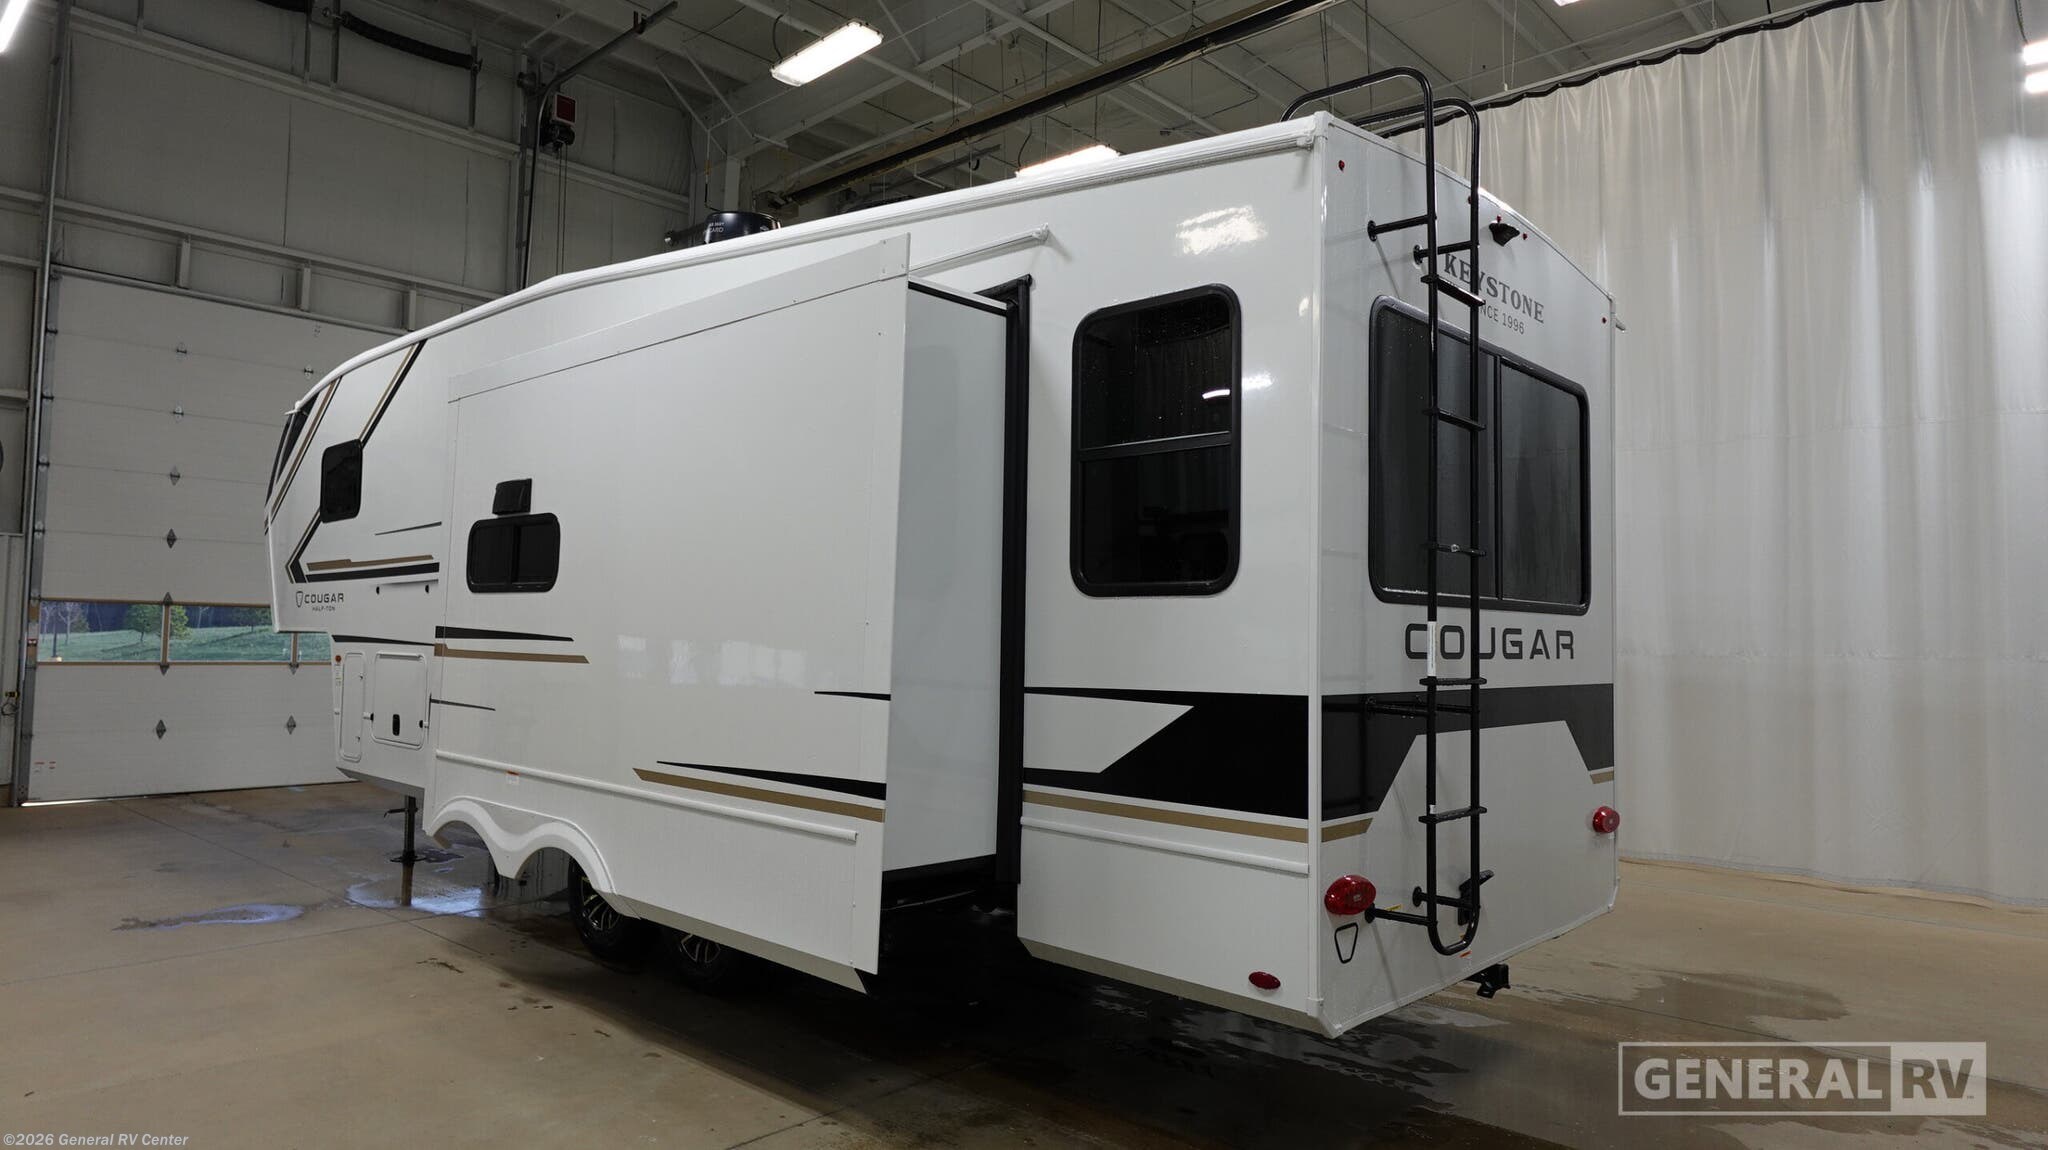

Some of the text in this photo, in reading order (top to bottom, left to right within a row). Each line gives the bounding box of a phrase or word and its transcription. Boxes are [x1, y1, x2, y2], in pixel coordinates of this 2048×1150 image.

[1480, 304, 1525, 335] NCE 1996
[304, 593, 345, 604] COUGAR
[1405, 623, 1574, 660] COUGAR
